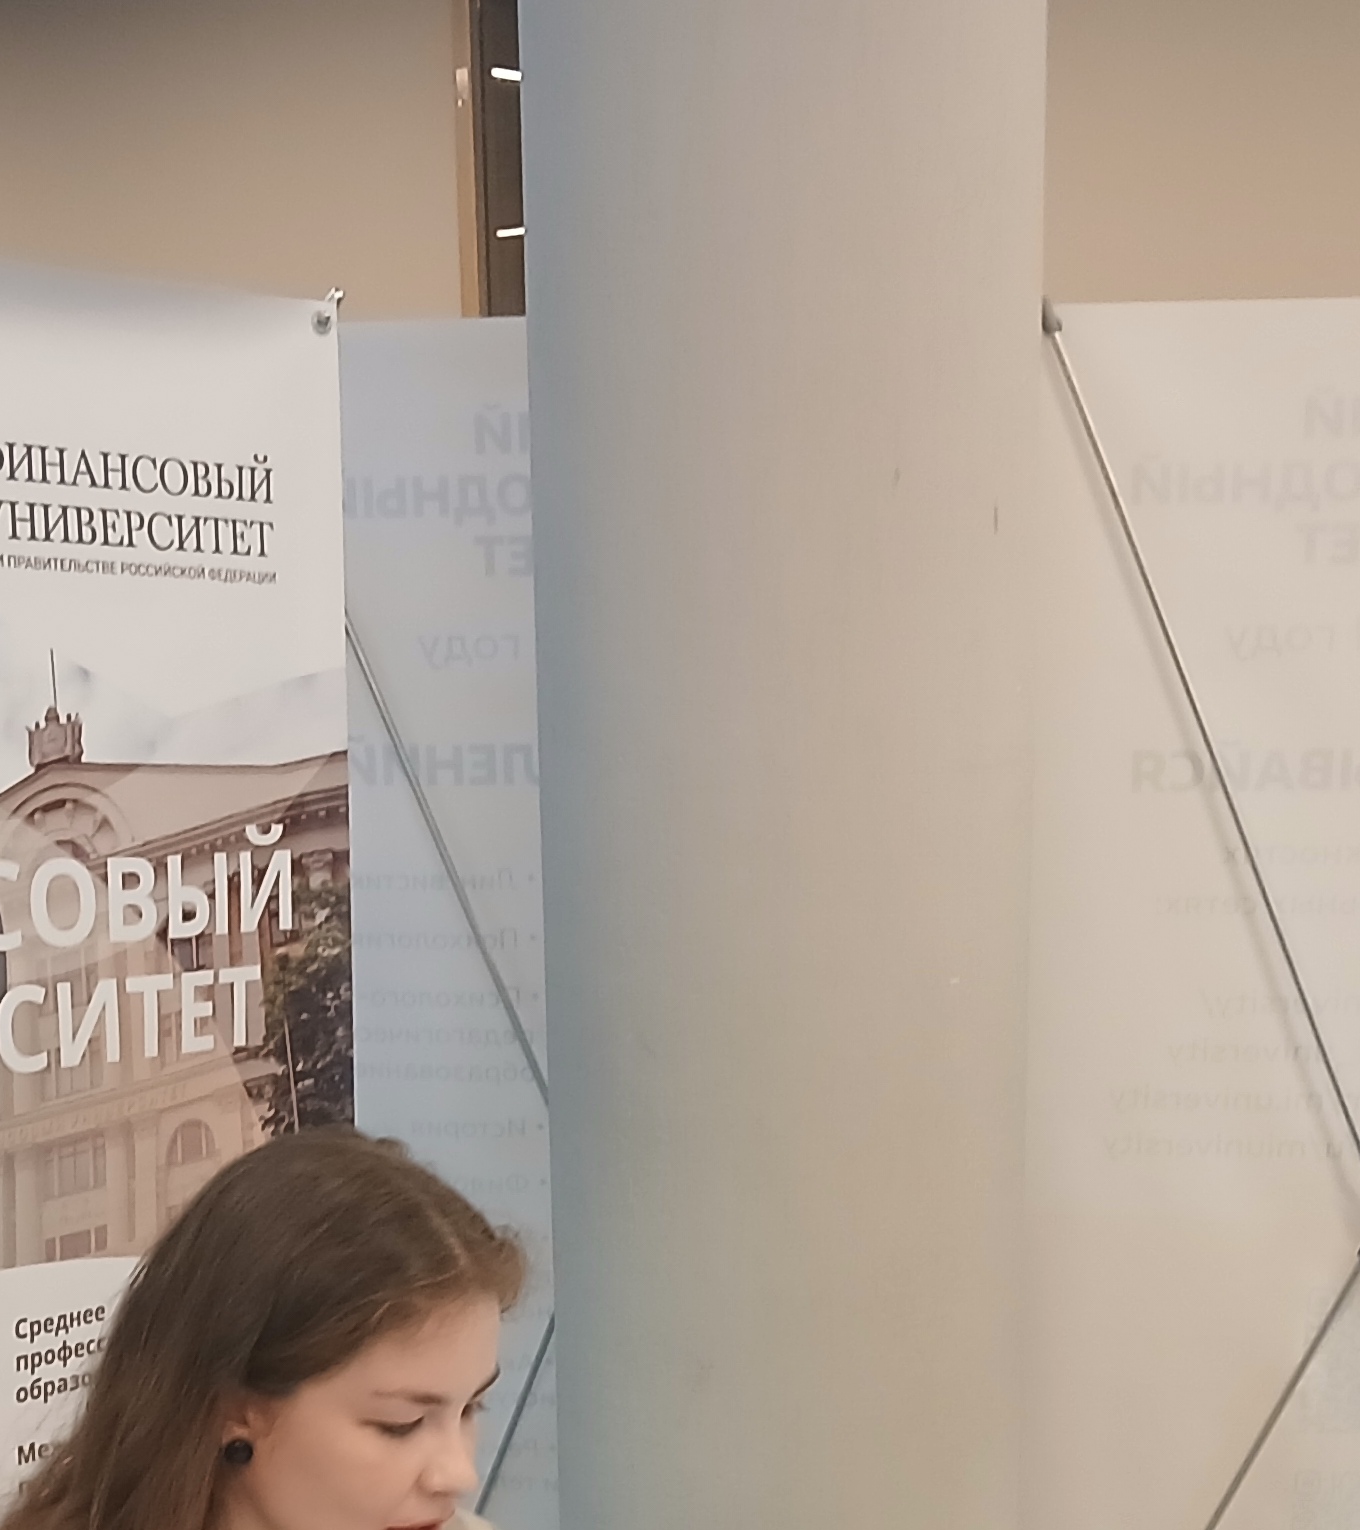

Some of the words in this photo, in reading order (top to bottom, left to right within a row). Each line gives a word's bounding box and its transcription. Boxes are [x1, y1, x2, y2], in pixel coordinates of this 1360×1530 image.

[8, 555, 118, 575] ПРАВИТЕЛЬСТВЕ
[121, 561, 205, 580] РОССИЙСКОЙ
[208, 568, 277, 584] ФЕДЕРАЦИИ
[15, 1305, 105, 1343] Среднее
